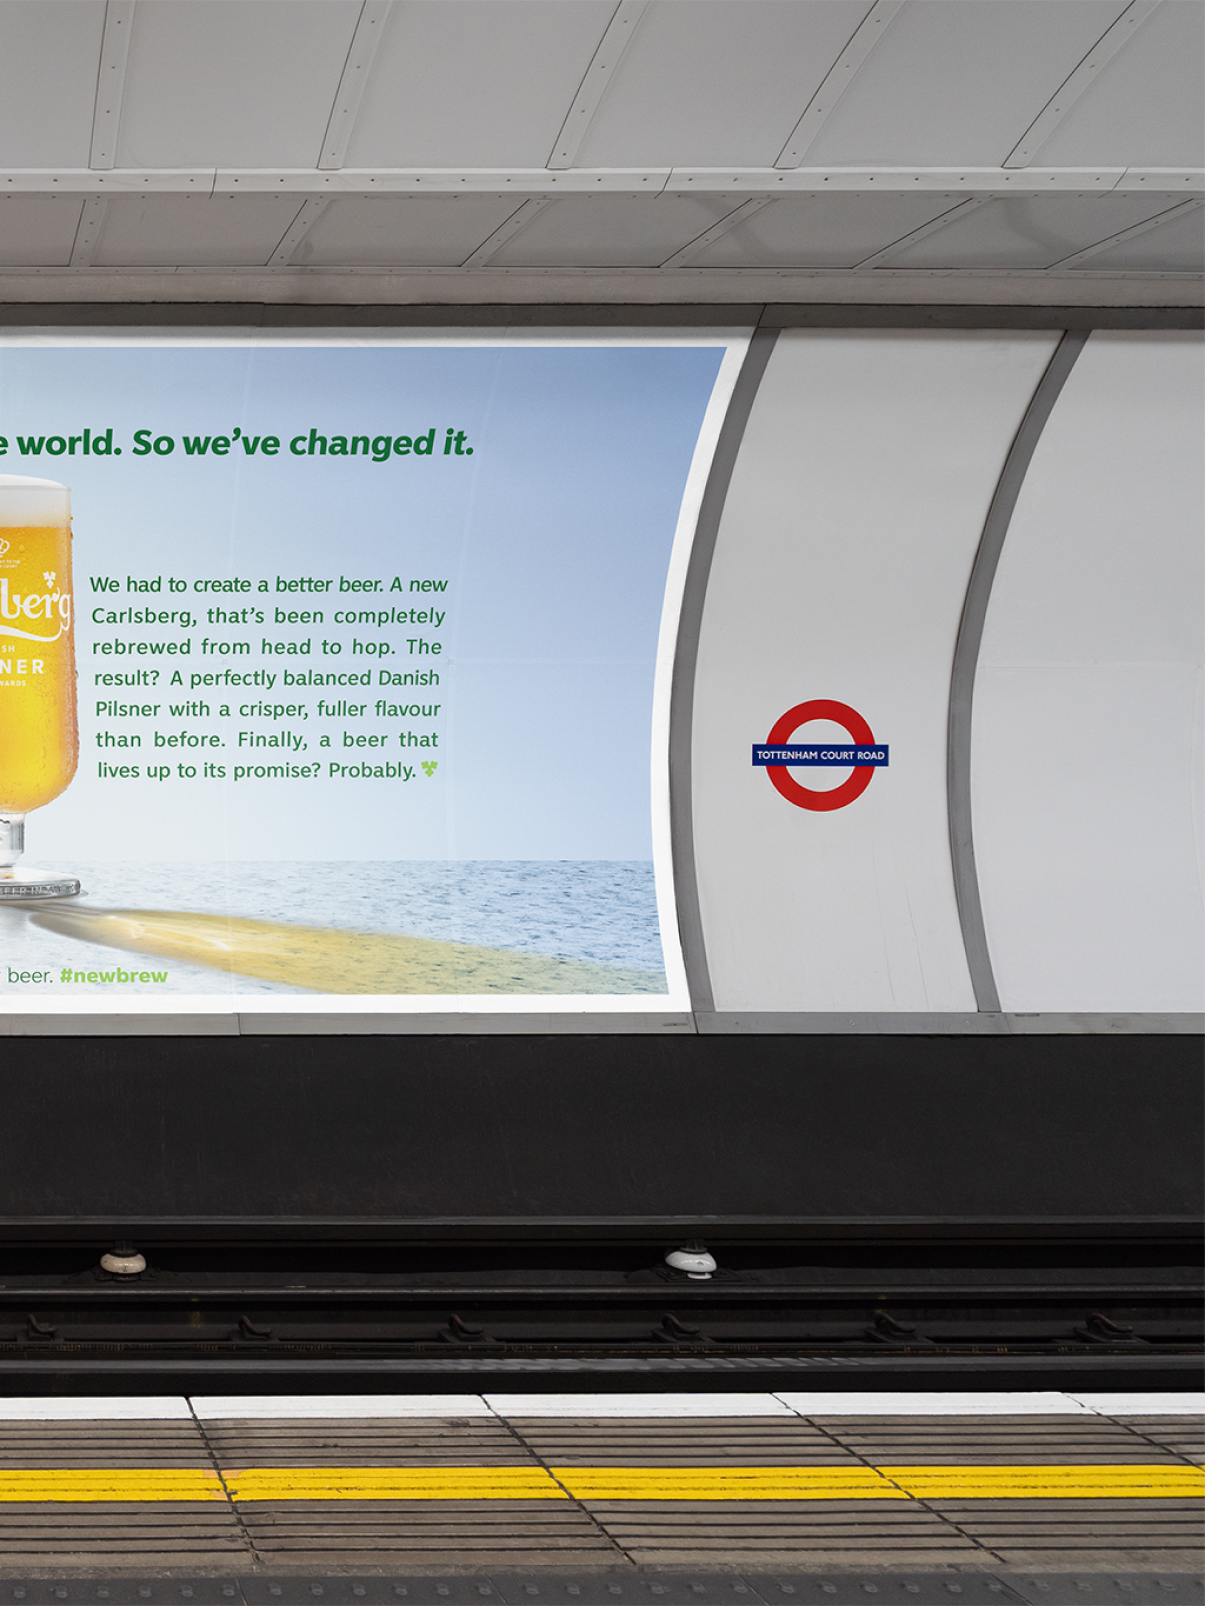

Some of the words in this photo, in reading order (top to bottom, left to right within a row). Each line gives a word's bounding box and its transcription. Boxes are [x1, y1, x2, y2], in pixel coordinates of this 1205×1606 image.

[15, 427, 123, 456] world.
[131, 429, 176, 456] So
[181, 426, 281, 456] we’ve
[289, 427, 437, 463] changed
[443, 427, 474, 456] it.
[89, 576, 121, 593] We
[126, 575, 162, 593] had
[167, 576, 188, 593] to
[193, 576, 252, 593] create
[257, 579, 270, 593] a
[275, 575, 334, 593] better
[338, 575, 384, 593] beer.
[389, 576, 403, 593] A
[409, 579, 449, 593] new
[91, 606, 198, 628] Carlsberg,
[206, 606, 265, 625] that’s
[274, 606, 324, 624] been
[333, 606, 446, 628] completely
[92, 638, 192, 655] rebrewed
[200, 637, 251, 655] from
[261, 637, 312, 655] head
[320, 639, 342, 655] to
[352, 637, 396, 659] hop.
[405, 638, 442, 655] The
[94, 669, 160, 687] result?
[169, 670, 184, 686] A
[190, 668, 278, 691] perfectly
[283, 668, 372, 687] balanced
[378, 668, 440, 687] Danish
[95, 700, 162, 717] Pilsner
[168, 699, 211, 717] with
[218, 704, 231, 717] a
[239, 700, 309, 721] crisper,
[316, 699, 368, 718] fuller
[374, 699, 442, 718] flavour
[95, 730, 142, 748] than
[154, 730, 226, 748] before.
[238, 730, 308, 752] Finally,
[319, 734, 332, 748] a
[342, 730, 389, 748] beer
[398, 730, 439, 748] that
[757, 751, 818, 760] TOTTENHAM
[820, 751, 854, 760] COURT
[857, 751, 886, 760] ROAD
[98, 761, 140, 779] lives
[146, 765, 171, 782] up
[176, 762, 197, 779] to
[203, 761, 227, 779] its
[233, 761, 321, 782] promise?
[329, 761, 417, 783] Probably.
[7, 967, 53, 984] beer.
[59, 966, 169, 984] #newbrew
